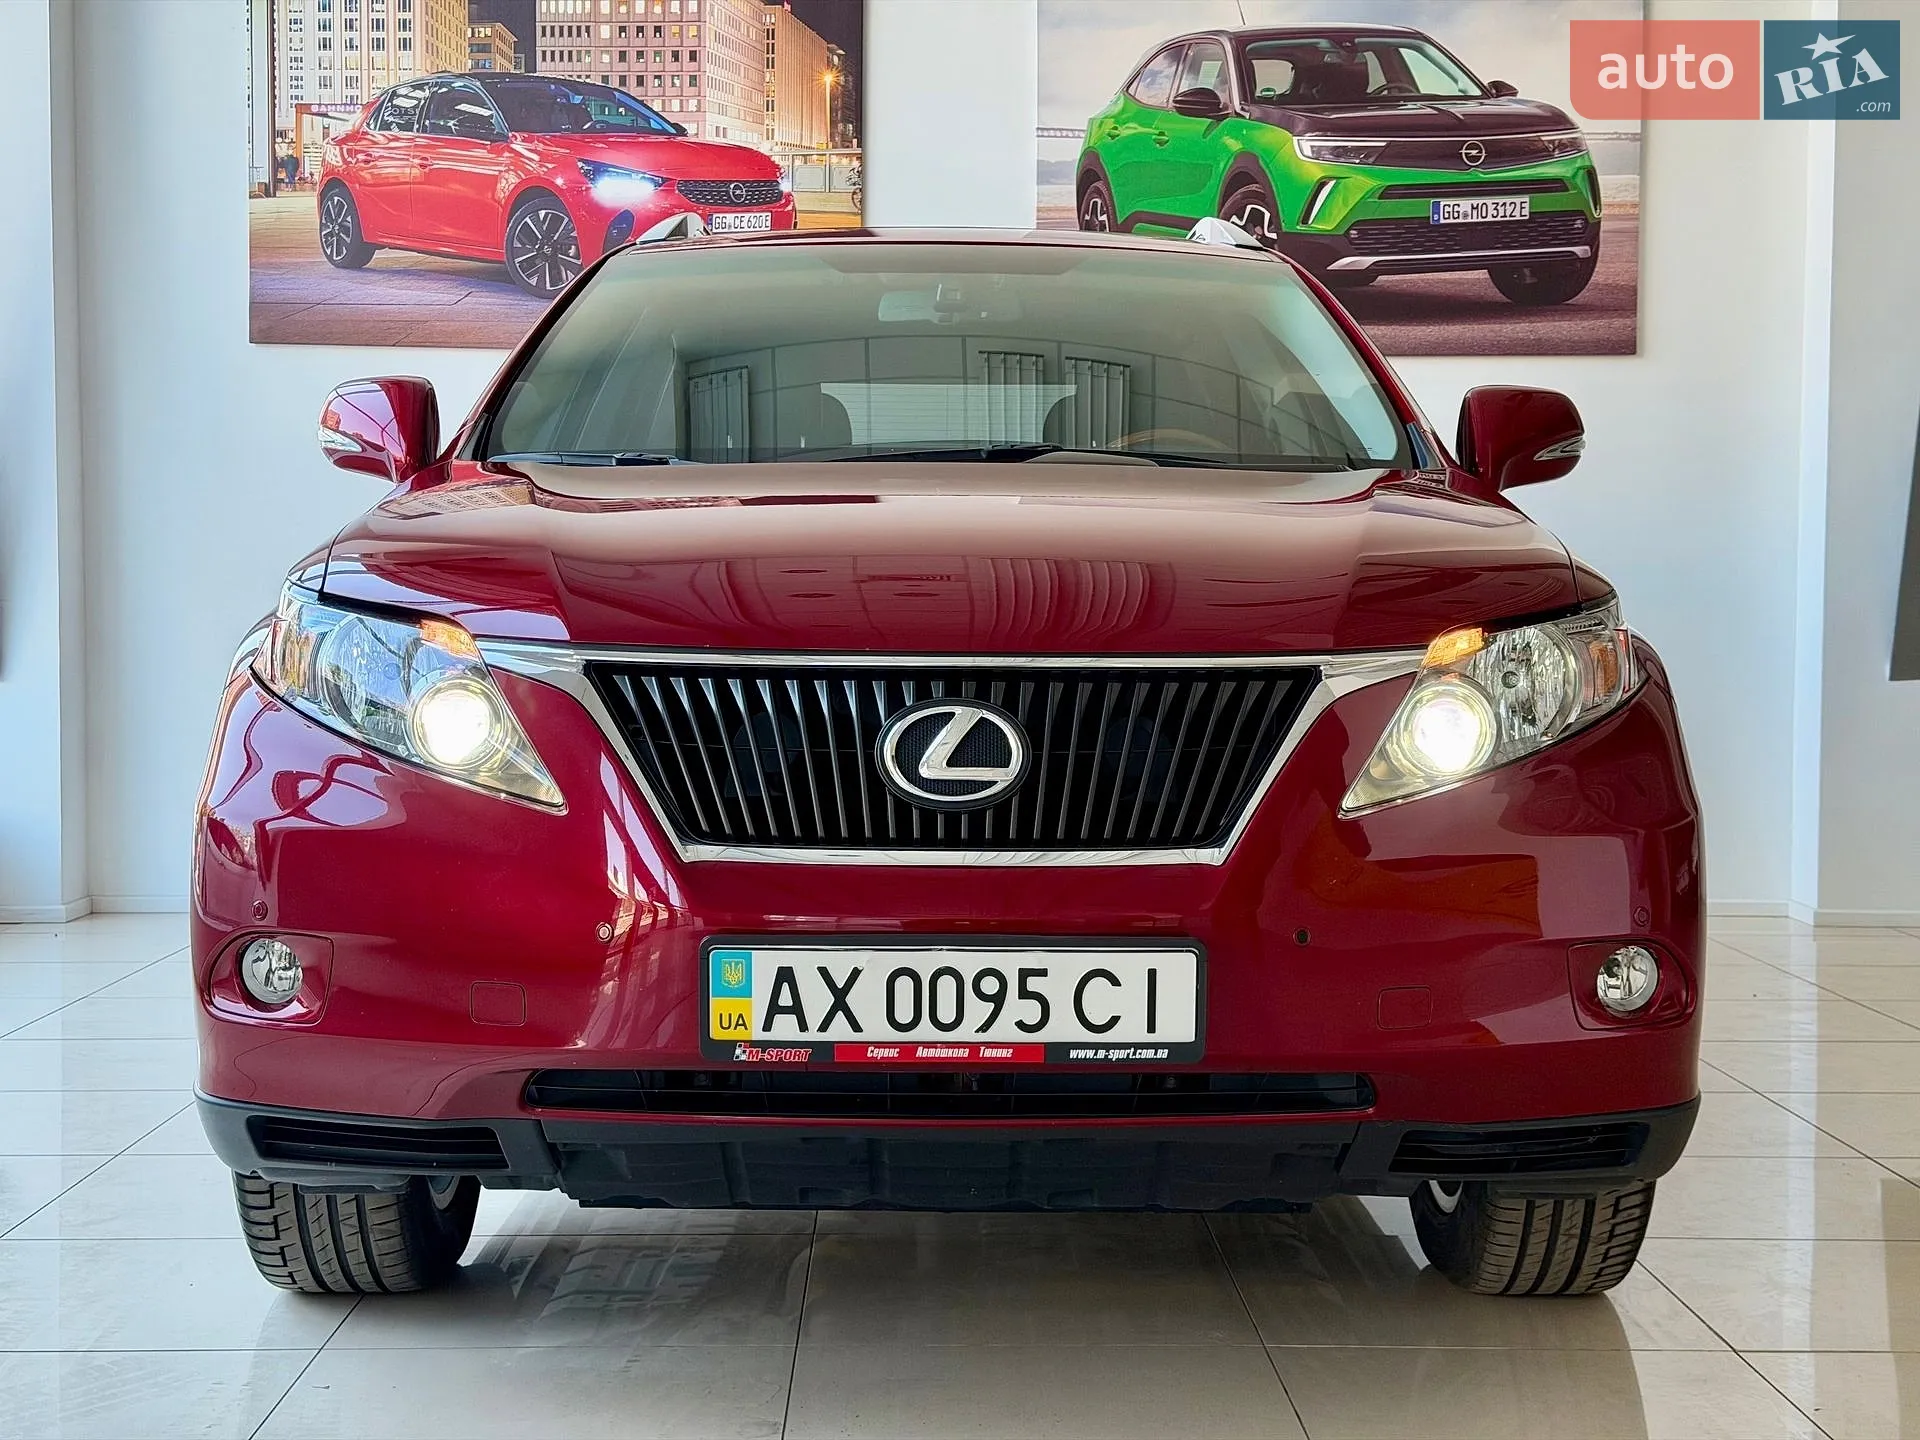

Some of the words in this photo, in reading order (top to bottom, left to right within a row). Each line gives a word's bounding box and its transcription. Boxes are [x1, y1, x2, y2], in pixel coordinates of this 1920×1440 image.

[761, 966, 864, 1033] AX
[886, 966, 1051, 1034] 0095
[1073, 968, 1157, 1034] CI
[719, 1013, 749, 1031] UA
[746, 1048, 812, 1062] M-SPORT
[867, 1046, 899, 1060] Сервис
[1069, 1047, 1169, 1062] www.m-sport.com.ua
